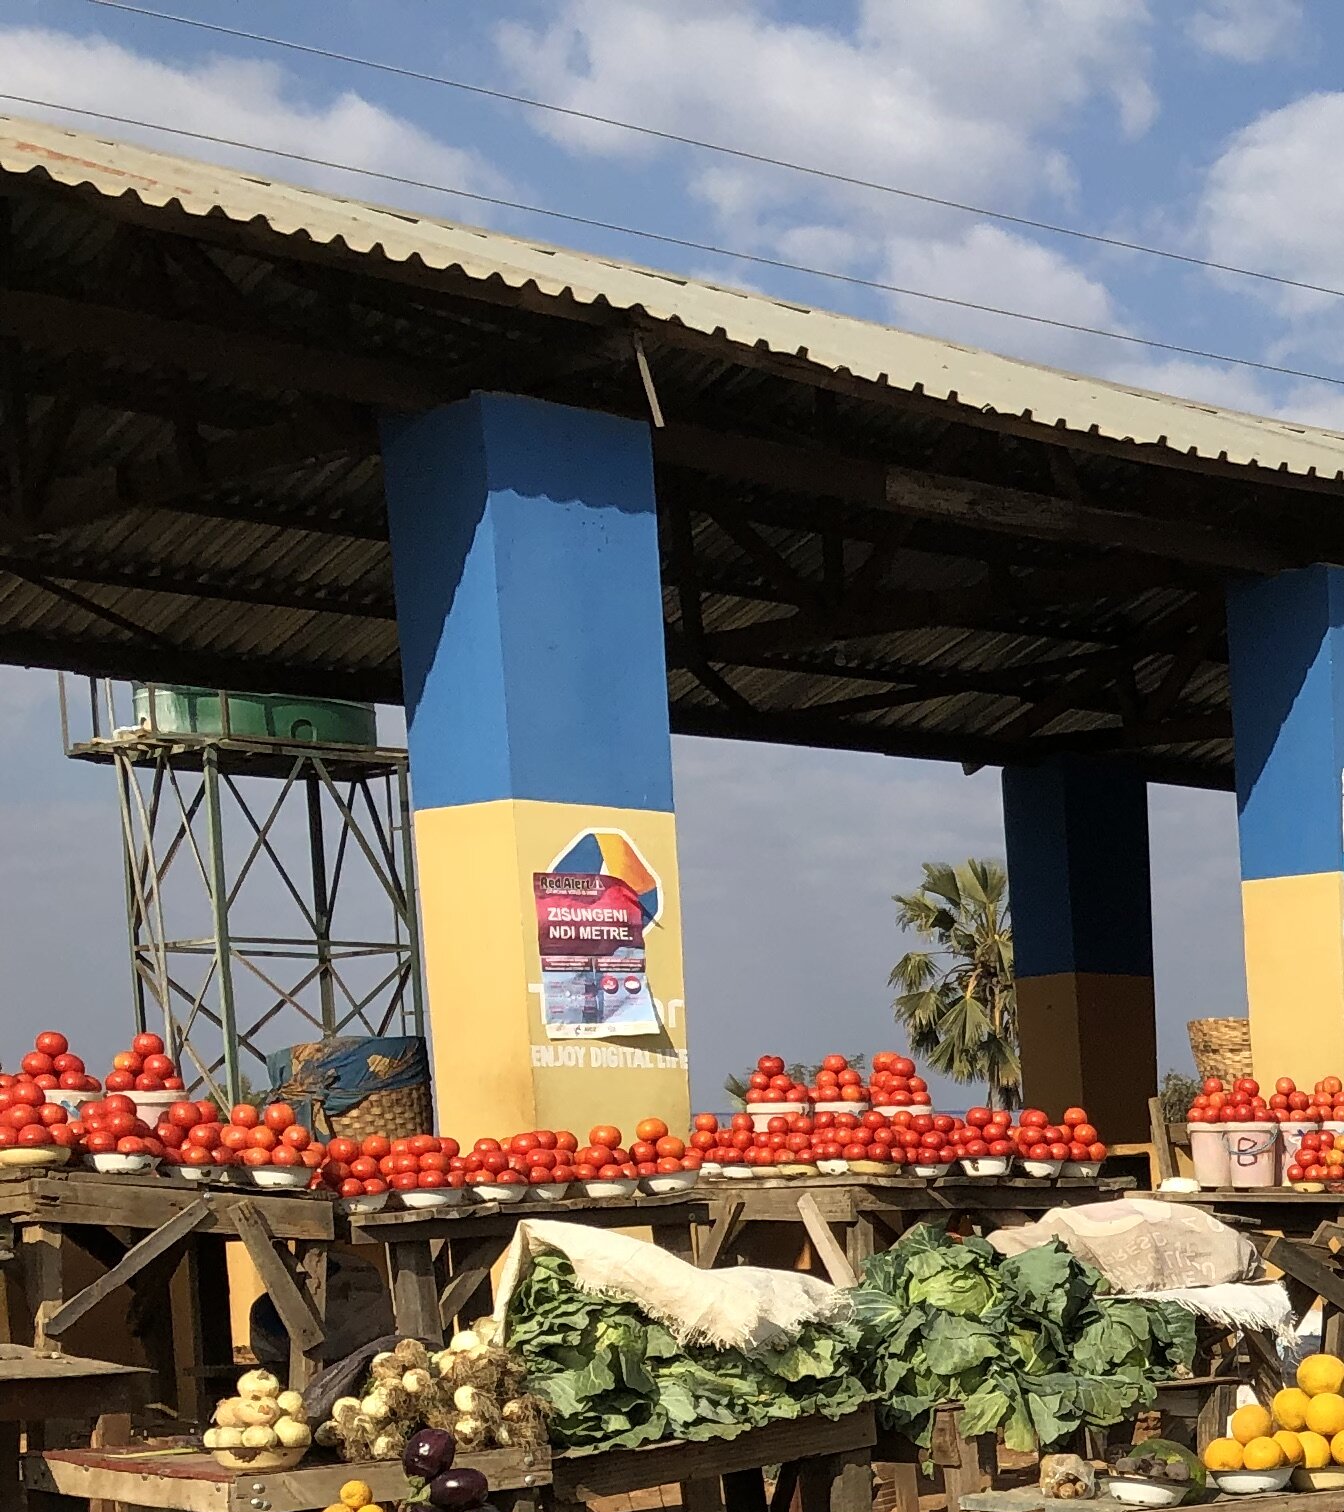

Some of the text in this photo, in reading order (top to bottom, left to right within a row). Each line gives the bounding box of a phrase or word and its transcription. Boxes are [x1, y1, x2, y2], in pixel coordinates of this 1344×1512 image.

[540, 876, 591, 890] Red Alert
[547, 907, 628, 923] ZISUNGENI
[549, 926, 634, 941] NDI METRE.
[531, 1045, 688, 1070] ENJOY DIGITAL LIFE
